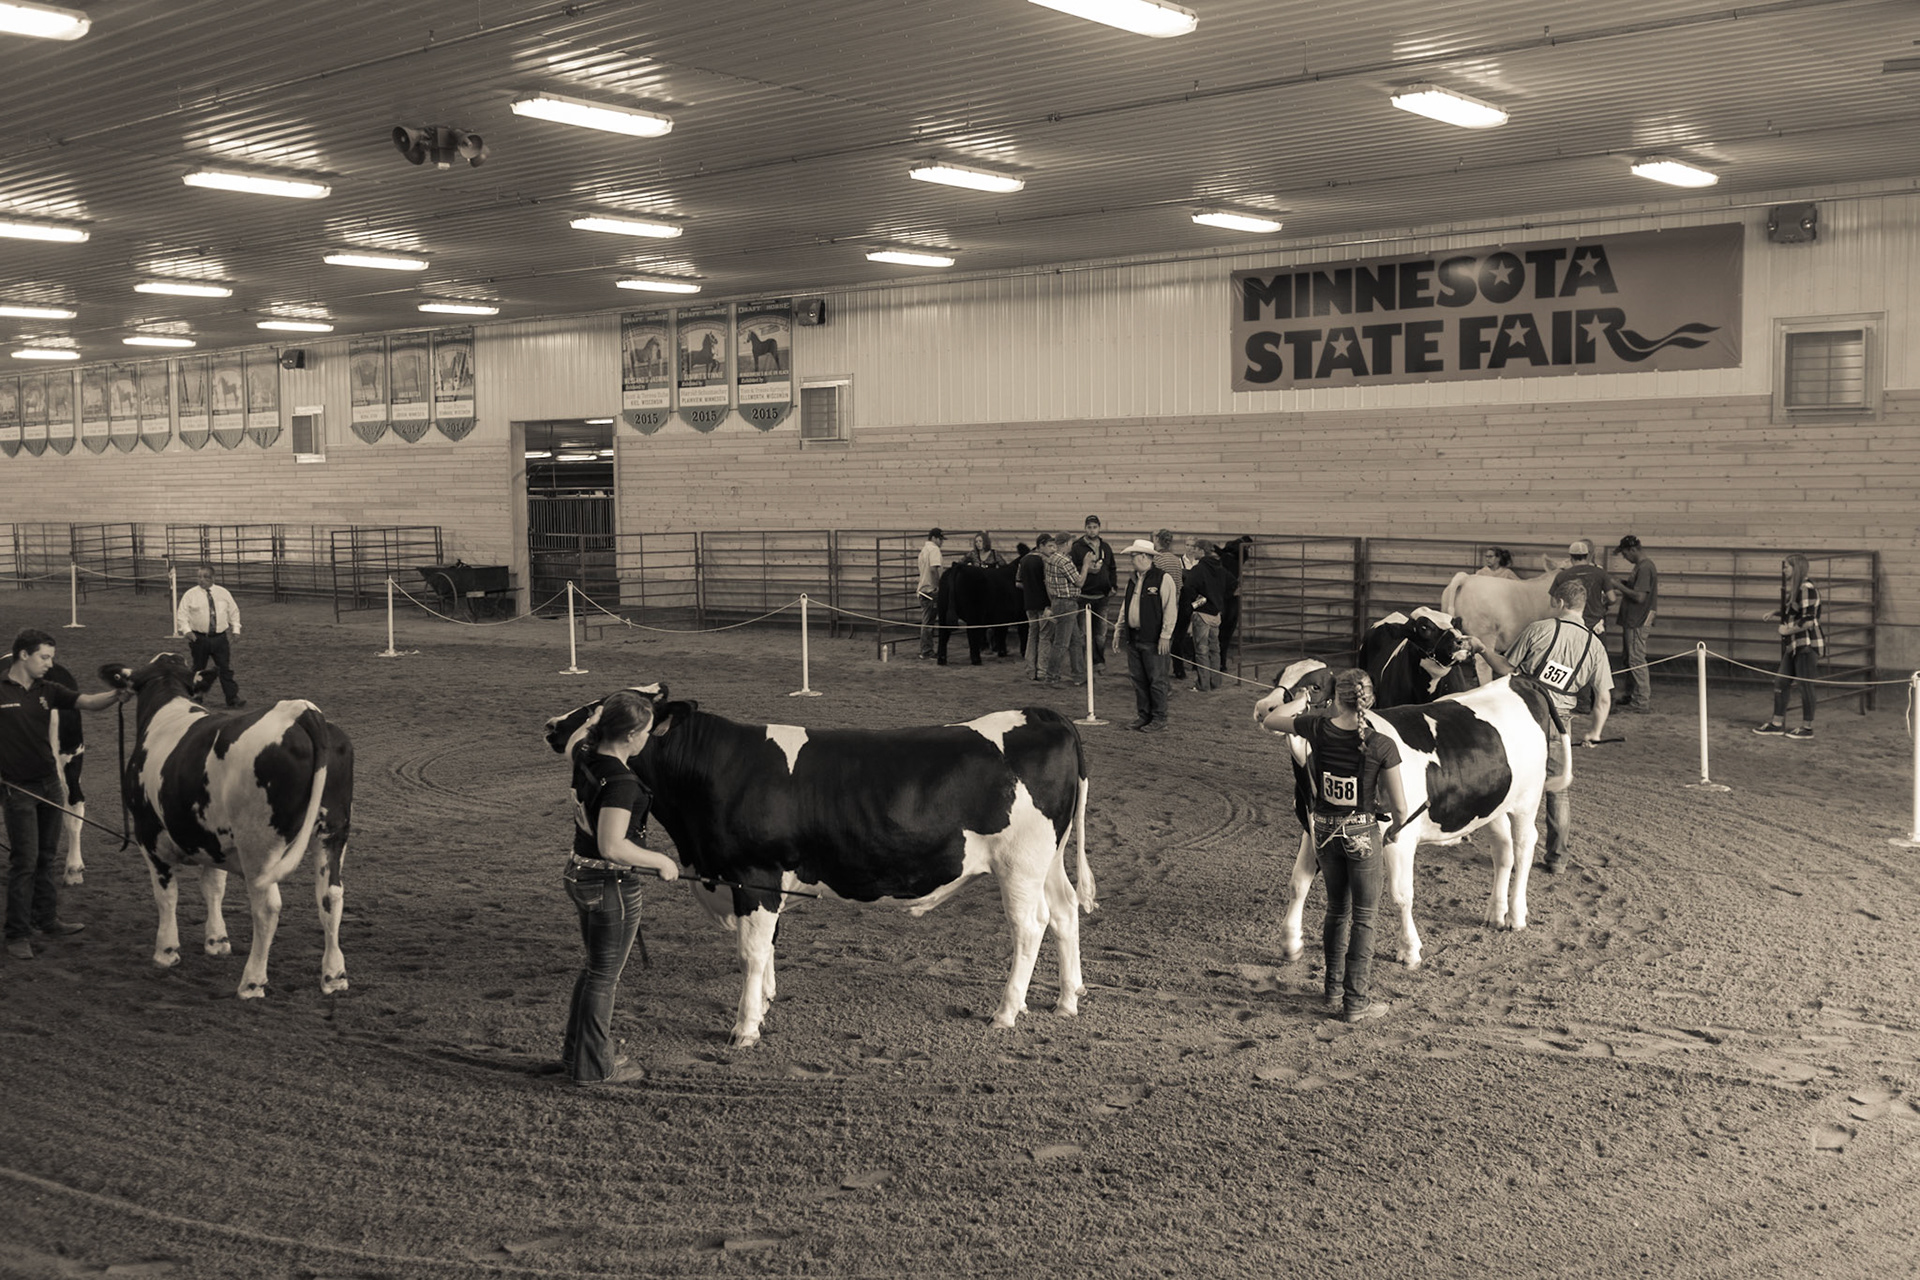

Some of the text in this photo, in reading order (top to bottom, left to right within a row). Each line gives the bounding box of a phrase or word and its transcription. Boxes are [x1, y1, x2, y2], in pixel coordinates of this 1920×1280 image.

[1243, 244, 1618, 322] MINNESOTA
[1243, 307, 1645, 384] STATE FAIR
[635, 414, 658, 425] 2015
[692, 411, 717, 422] 2015
[752, 408, 778, 420] 2015
[1543, 665, 1568, 684] 357
[1325, 778, 1354, 800] 358
